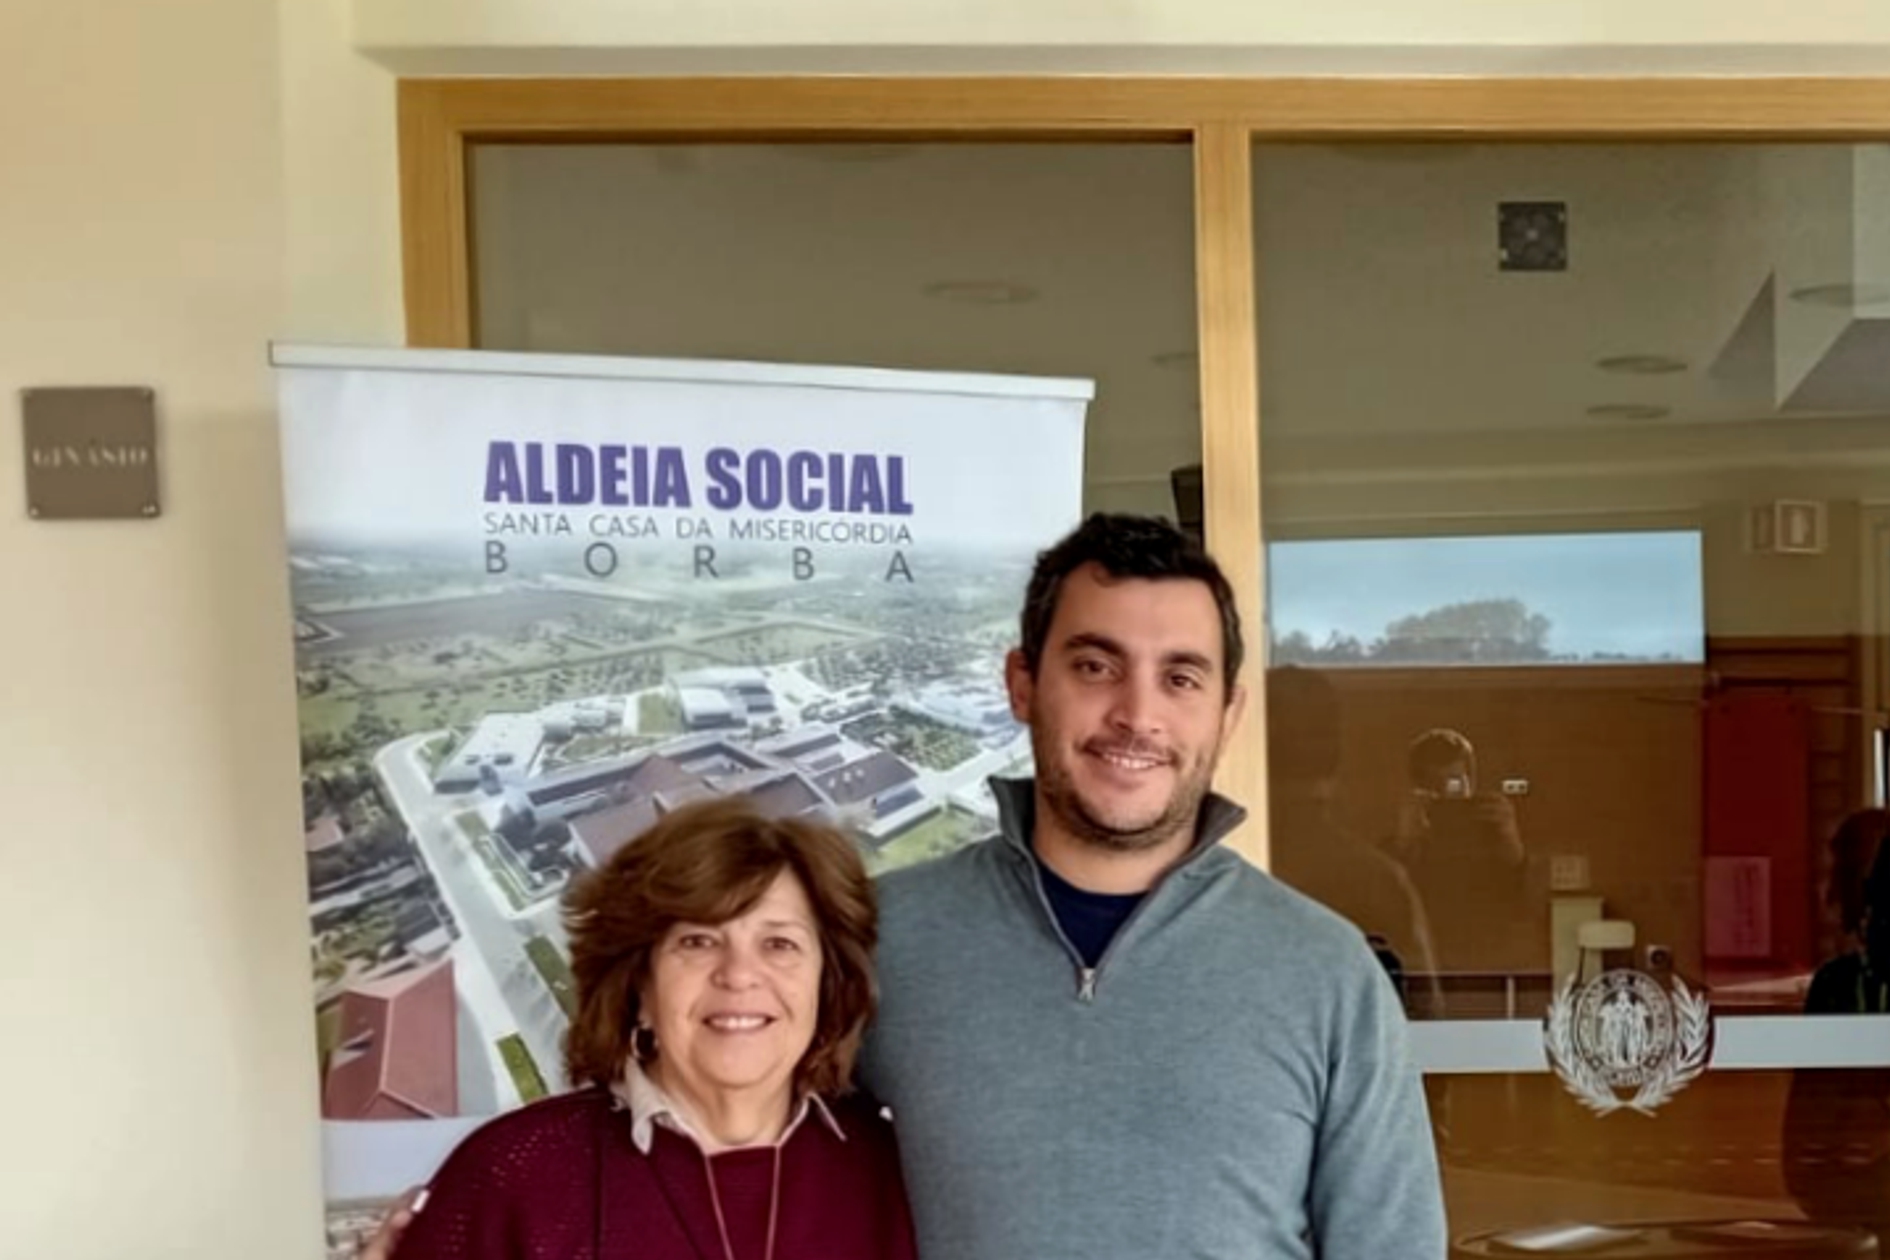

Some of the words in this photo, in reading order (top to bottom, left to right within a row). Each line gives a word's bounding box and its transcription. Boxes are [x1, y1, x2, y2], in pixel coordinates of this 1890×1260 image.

[484, 441, 692, 507] ALDEIA
[705, 447, 913, 515] SOCIAL
[484, 512, 571, 536] SANTA
[589, 514, 659, 538] CASA
[677, 518, 713, 540] DA
[729, 515, 912, 545] MISERICÓRDIA
